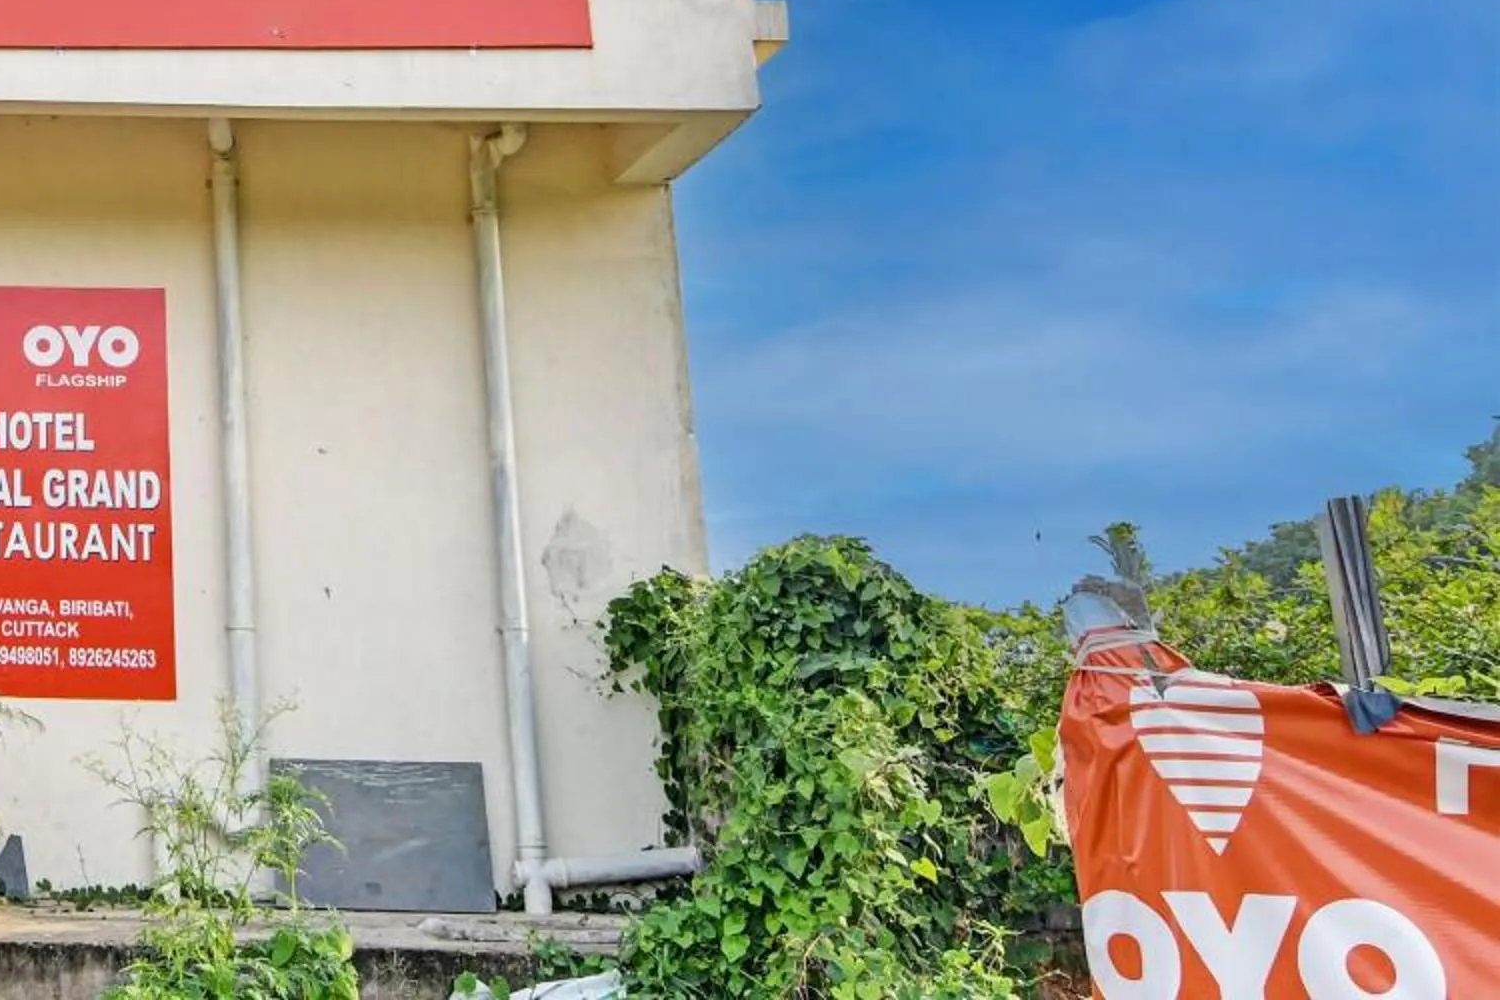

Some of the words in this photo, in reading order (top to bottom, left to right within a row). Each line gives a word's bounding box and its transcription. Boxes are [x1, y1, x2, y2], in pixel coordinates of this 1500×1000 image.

[22, 325, 140, 368] OYO
[35, 373, 128, 387] FLAGSHIP
[42, 468, 161, 510] GRAND
[59, 599, 133, 619] BIRIBATI,
[1, 620, 79, 638] CUTTACK
[69, 647, 156, 668] 8926245263
[1083, 890, 1447, 1000] OYO
